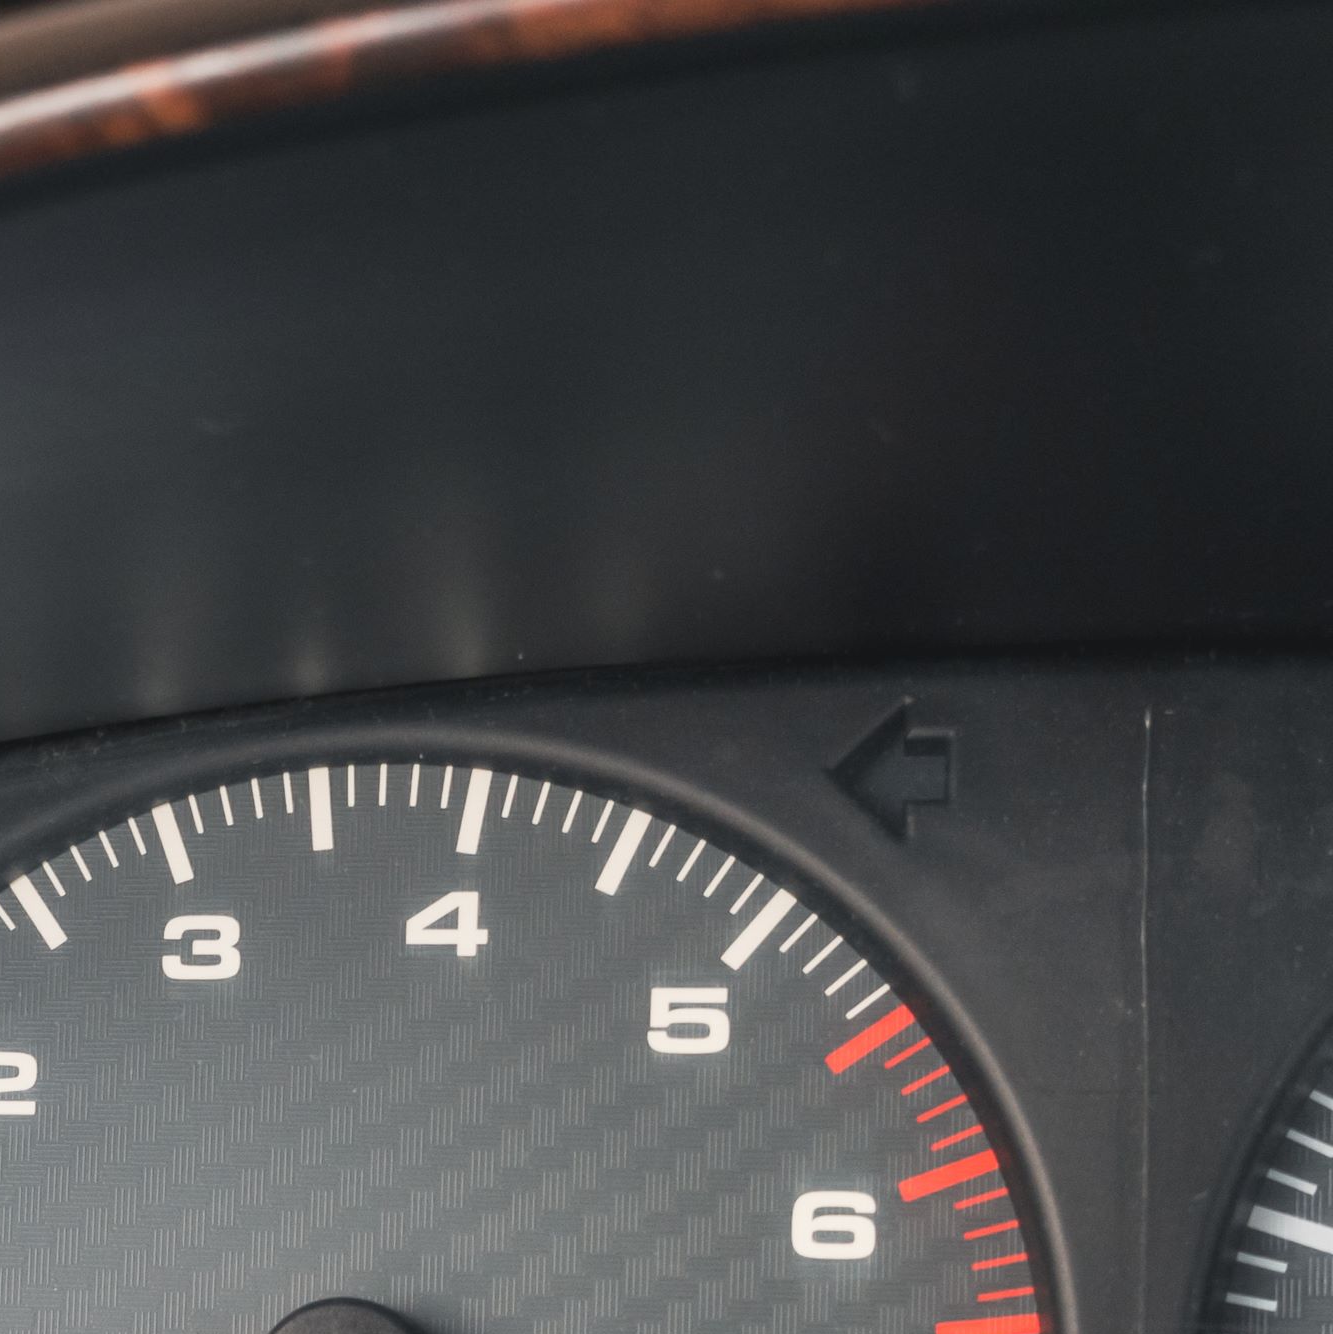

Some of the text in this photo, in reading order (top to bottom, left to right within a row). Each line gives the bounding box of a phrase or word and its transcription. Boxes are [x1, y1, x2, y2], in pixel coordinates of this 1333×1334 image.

[162, 914, 241, 981] 3
[406, 891, 489, 958] 4
[647, 986, 730, 1055] 5
[791, 1190, 877, 1260] 6
